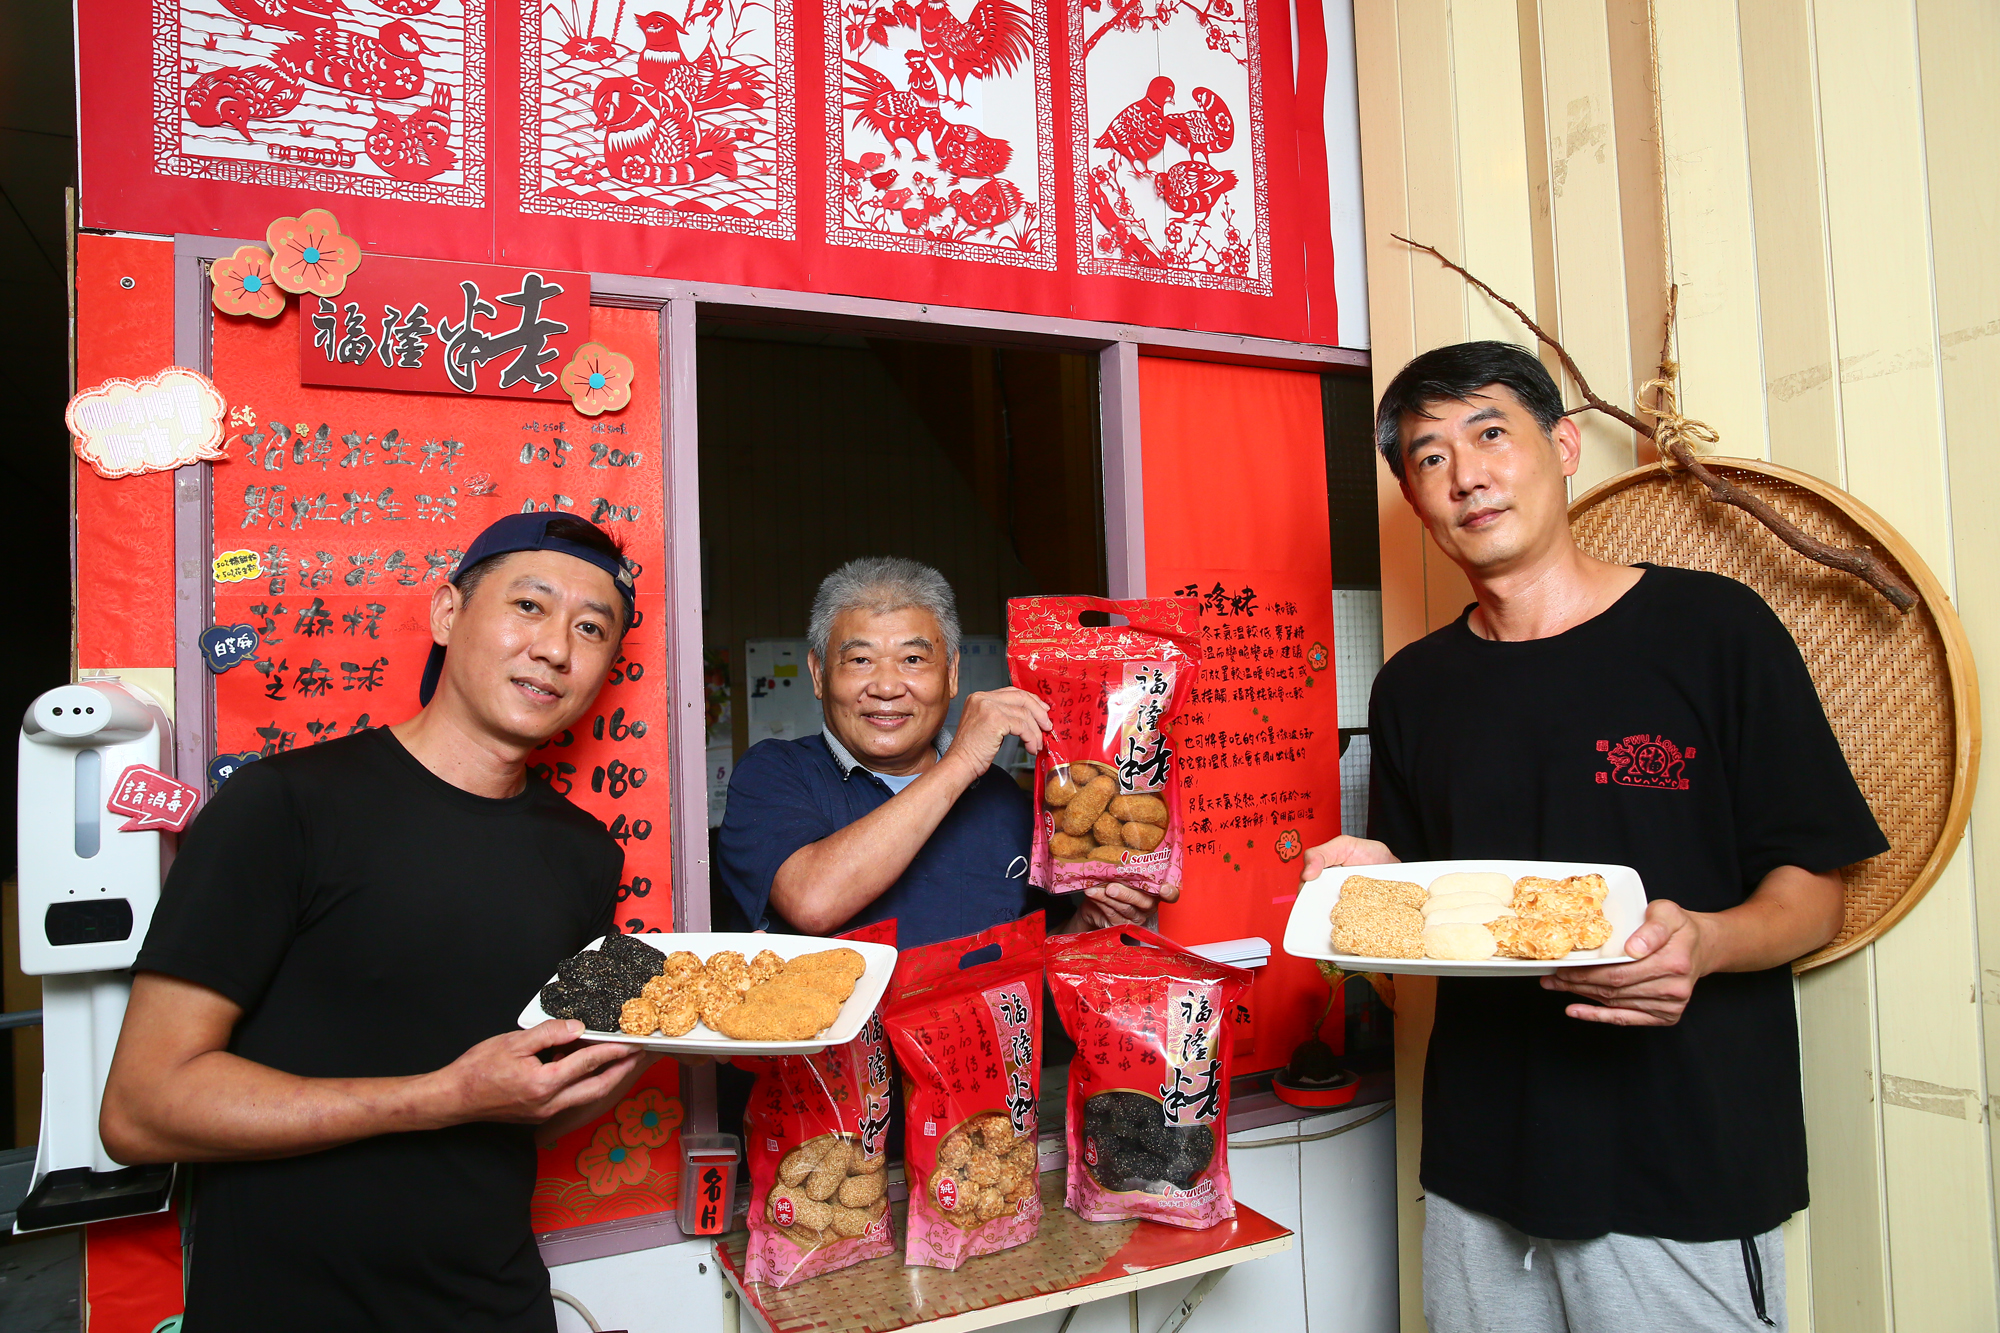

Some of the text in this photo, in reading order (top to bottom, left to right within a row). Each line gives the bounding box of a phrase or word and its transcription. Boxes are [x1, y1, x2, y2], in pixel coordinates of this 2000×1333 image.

[520, 437, 573, 468] 105
[589, 443, 643, 469] 200
[590, 498, 641, 524] 200
[214, 632, 253, 657] 白芝麻
[254, 657, 388, 701] 芝麻球
[593, 707, 648, 742] 160
[1623, 734, 1650, 747] FWU
[1655, 735, 1682, 761] LONG
[591, 759, 648, 799] 180
[1180, 774, 1199, 789] 感！
[123, 780, 182, 813] 請消毒
[599, 813, 652, 846] 40
[1130, 848, 1171, 864] souvenir
[702, 1167, 722, 1230] 名片
[939, 1181, 956, 1207] 純素
[1173, 1179, 1212, 1199] souvenir
[776, 1200, 792, 1223] 純素
